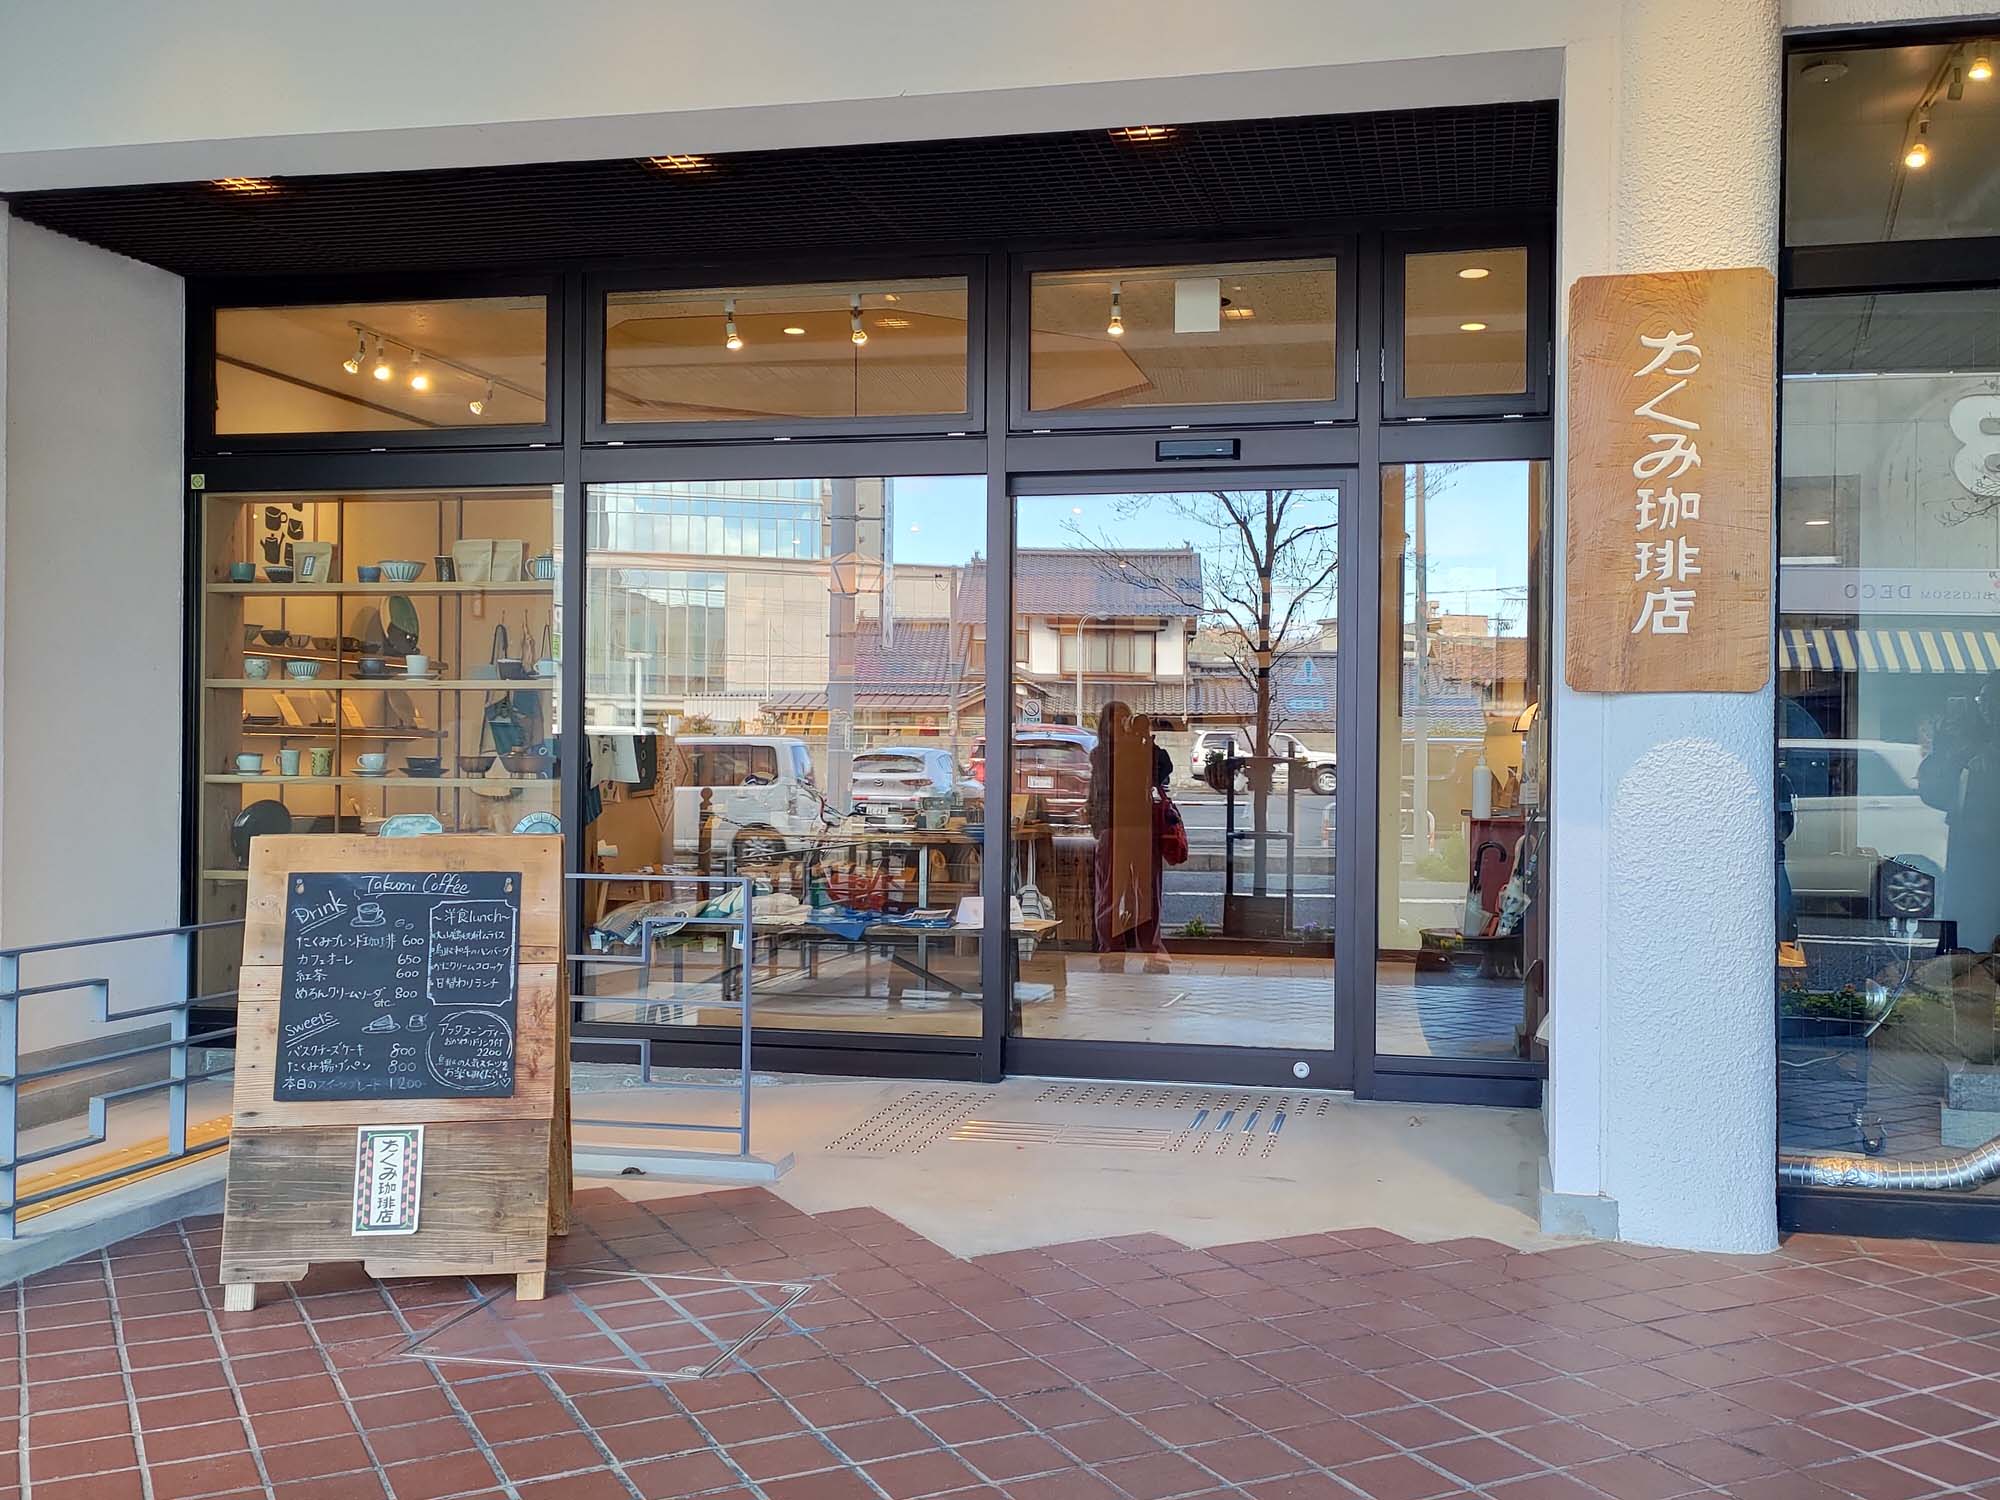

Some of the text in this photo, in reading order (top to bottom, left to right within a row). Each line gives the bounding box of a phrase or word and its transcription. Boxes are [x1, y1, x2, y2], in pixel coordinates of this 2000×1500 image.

[1631, 329, 1702, 635] たくみ珈琲店
[360, 873, 471, 894] Takumi Coffee
[291, 890, 348, 924] Drink
[296, 932, 424, 950] たくみブレンド珈琲 600
[297, 952, 421, 966] カフェオーレ 650
[295, 969, 419, 983] 紅茶 600
[295, 987, 418, 1000] めろんクリームソーダ 800
[284, 1011, 334, 1037] Sweets
[287, 1041, 416, 1058] バスクチーズケーキ 800
[476, 1048, 502, 1057] 2200
[287, 1059, 416, 1074] たくみ揚げパン 800
[375, 1139, 399, 1224] たくみ珈琲店
